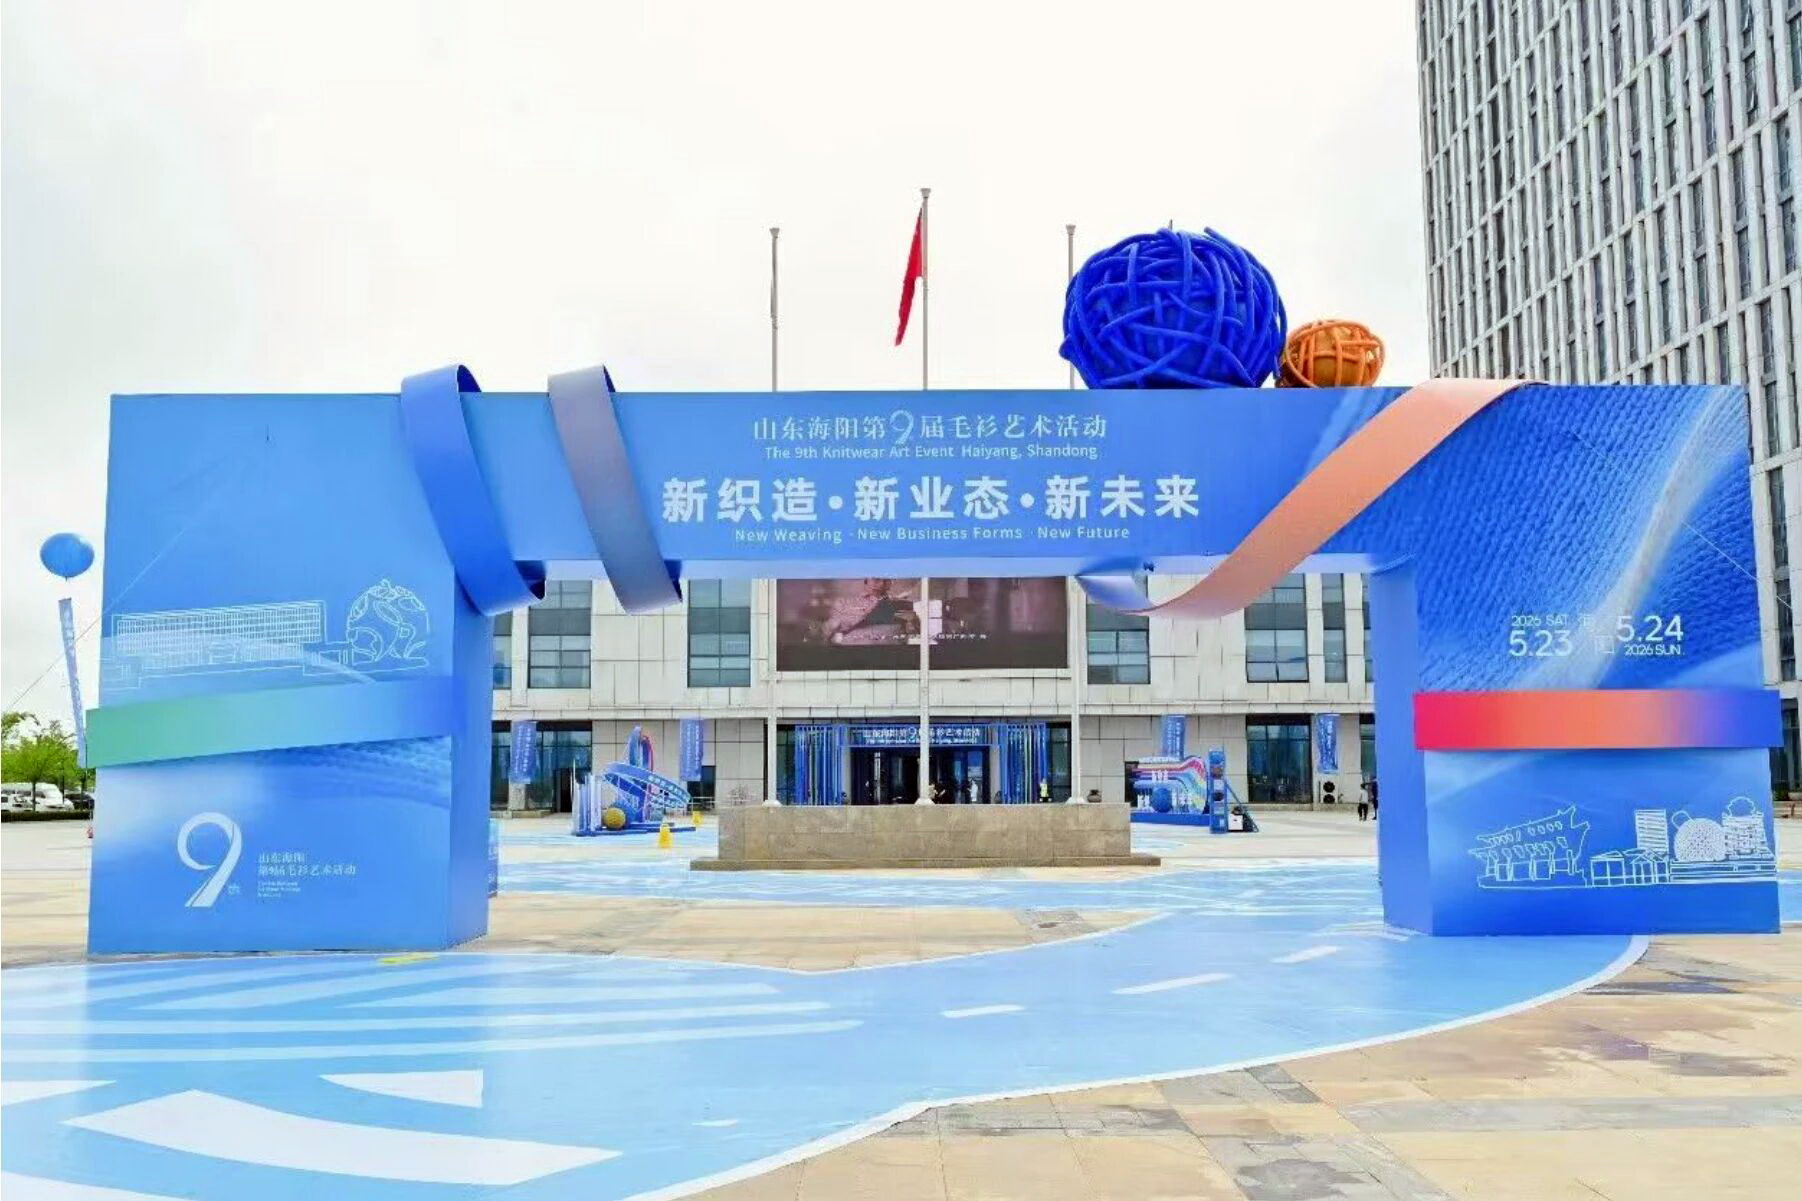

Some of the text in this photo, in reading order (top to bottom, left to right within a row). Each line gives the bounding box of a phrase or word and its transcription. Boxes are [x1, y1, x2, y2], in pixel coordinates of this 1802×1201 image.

[754, 409, 1107, 445] 山东海阳第9届毛衫艺术活动
[765, 444, 1098, 460] The 9th Knitwear Art Event Haiyang, Shandong
[735, 525, 1130, 544] New Weaving New Business Forms New Future
[1511, 615, 1568, 627] 2026 SAT
[1616, 615, 1684, 642] 5.24
[1509, 629, 1573, 657] 5.23
